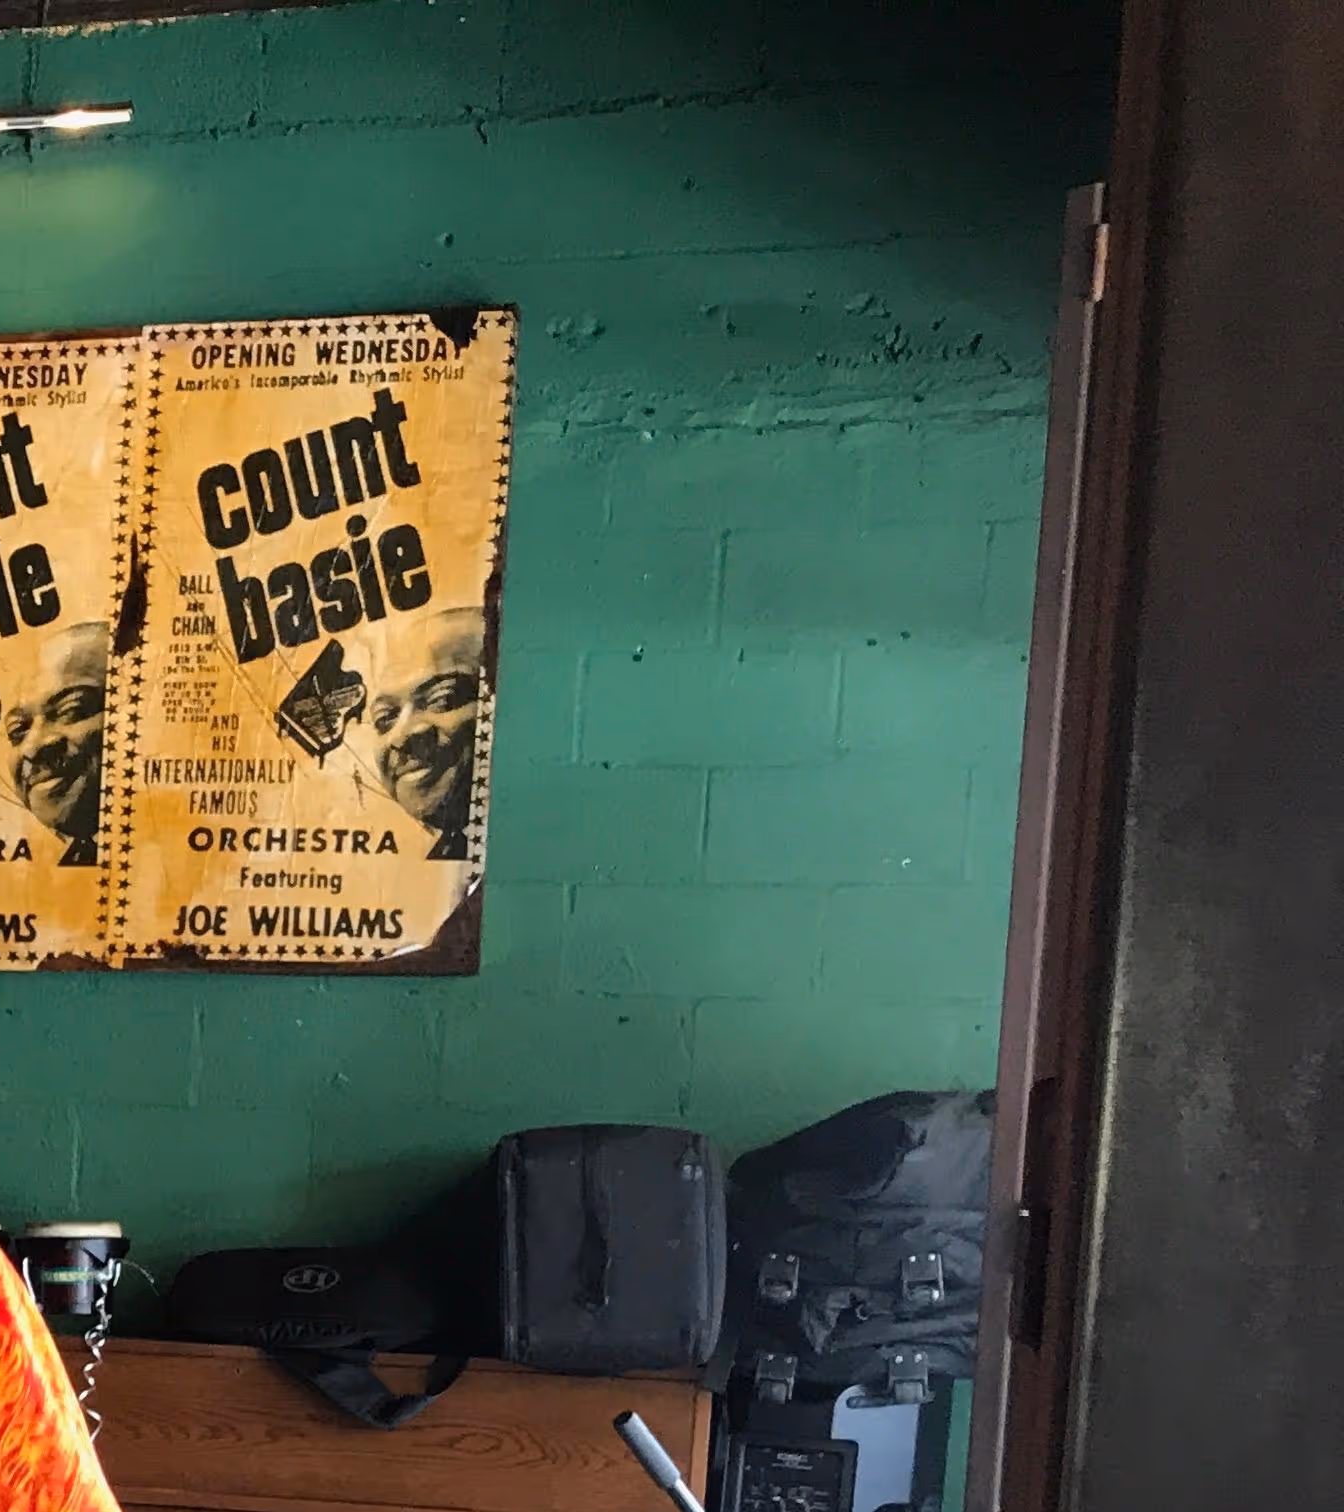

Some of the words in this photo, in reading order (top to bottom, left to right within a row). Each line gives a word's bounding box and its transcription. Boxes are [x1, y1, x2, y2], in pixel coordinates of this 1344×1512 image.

[192, 343, 295, 369] OPENING
[197, 387, 421, 549] count
[179, 575, 213, 595] BALL
[216, 515, 432, 664] basie
[172, 616, 216, 636] CHAIN
[210, 714, 239, 731] AND
[212, 735, 235, 752] HIS
[144, 759, 295, 784] INTERNATIONALLY
[190, 790, 258, 816] FAMOUS
[188, 826, 398, 855] ORCHESTRA
[240, 866, 342, 894] Featuring
[173, 905, 228, 936] JOE
[249, 905, 403, 940] WILLIAMS
